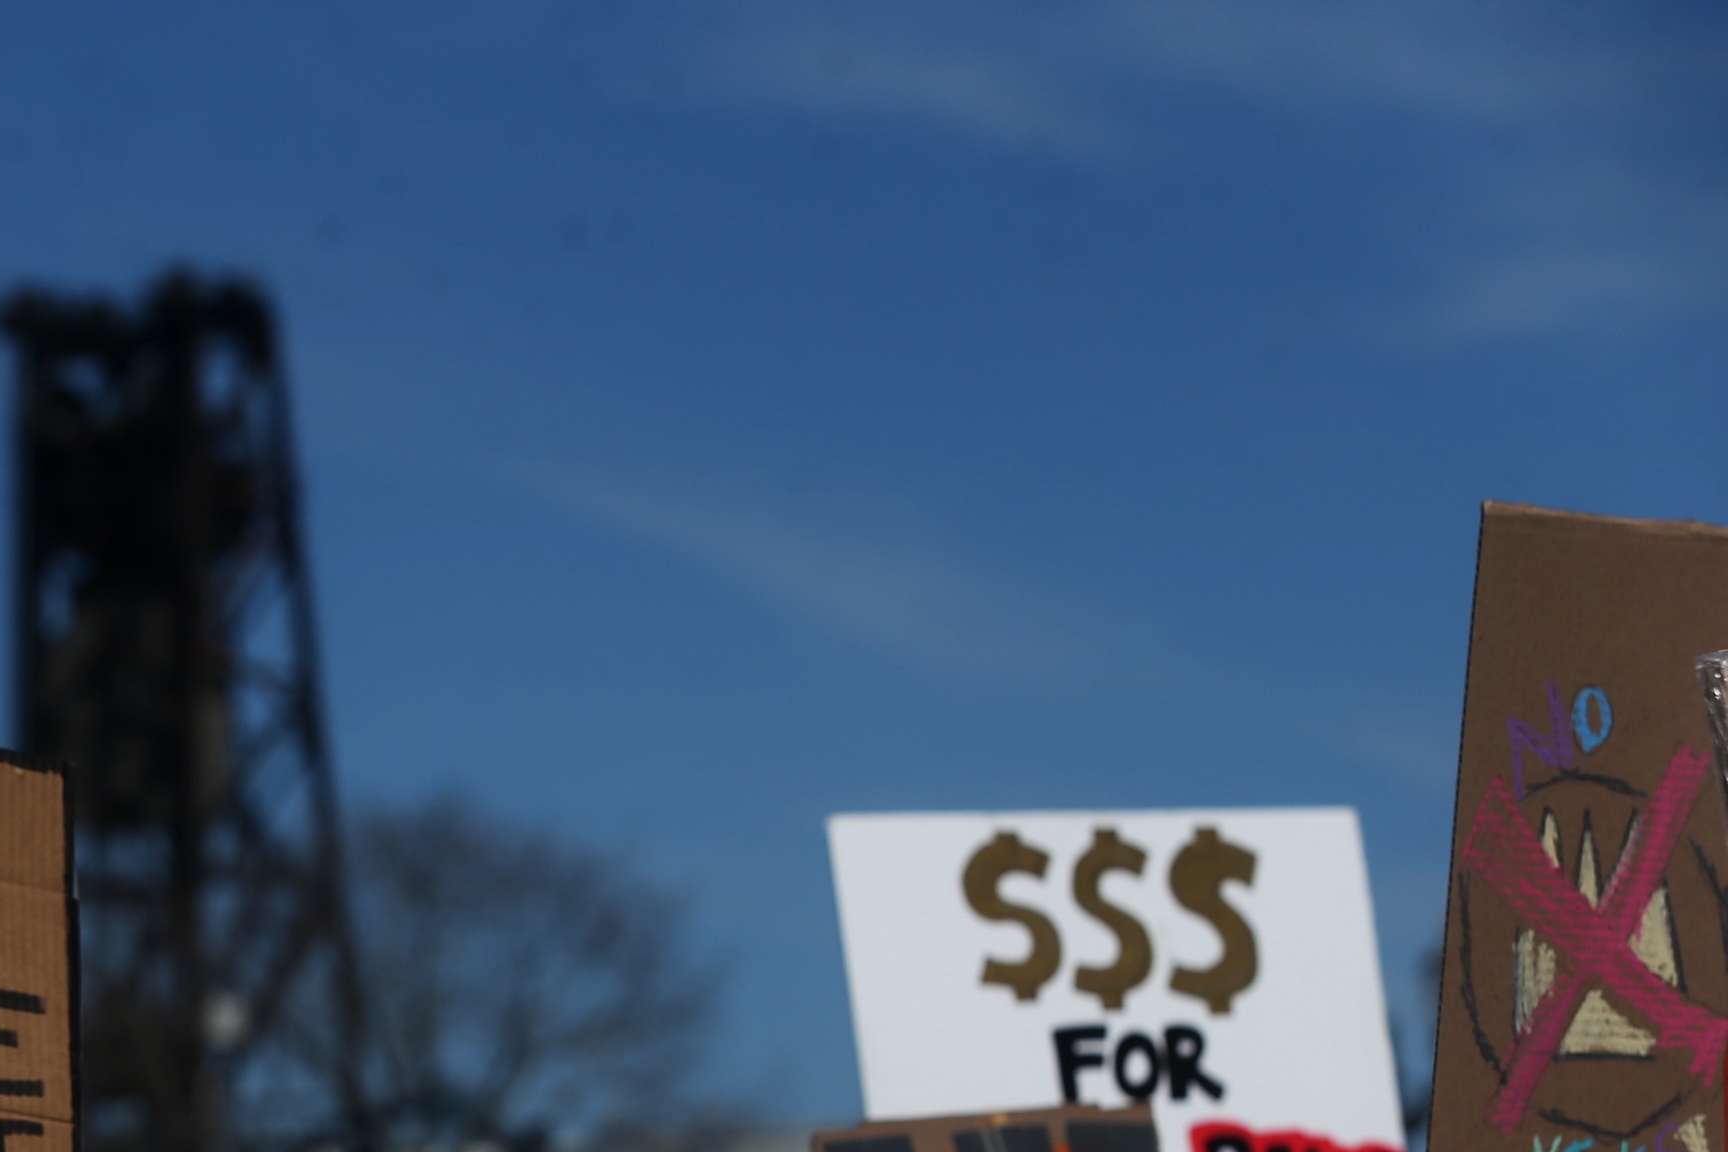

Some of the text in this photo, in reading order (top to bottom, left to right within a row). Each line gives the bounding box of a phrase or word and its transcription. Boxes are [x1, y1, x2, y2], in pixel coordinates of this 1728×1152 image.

[1506, 680, 1614, 800] NO
[962, 825, 1259, 1017] $$$
[1053, 1026, 1225, 1102] FOR
